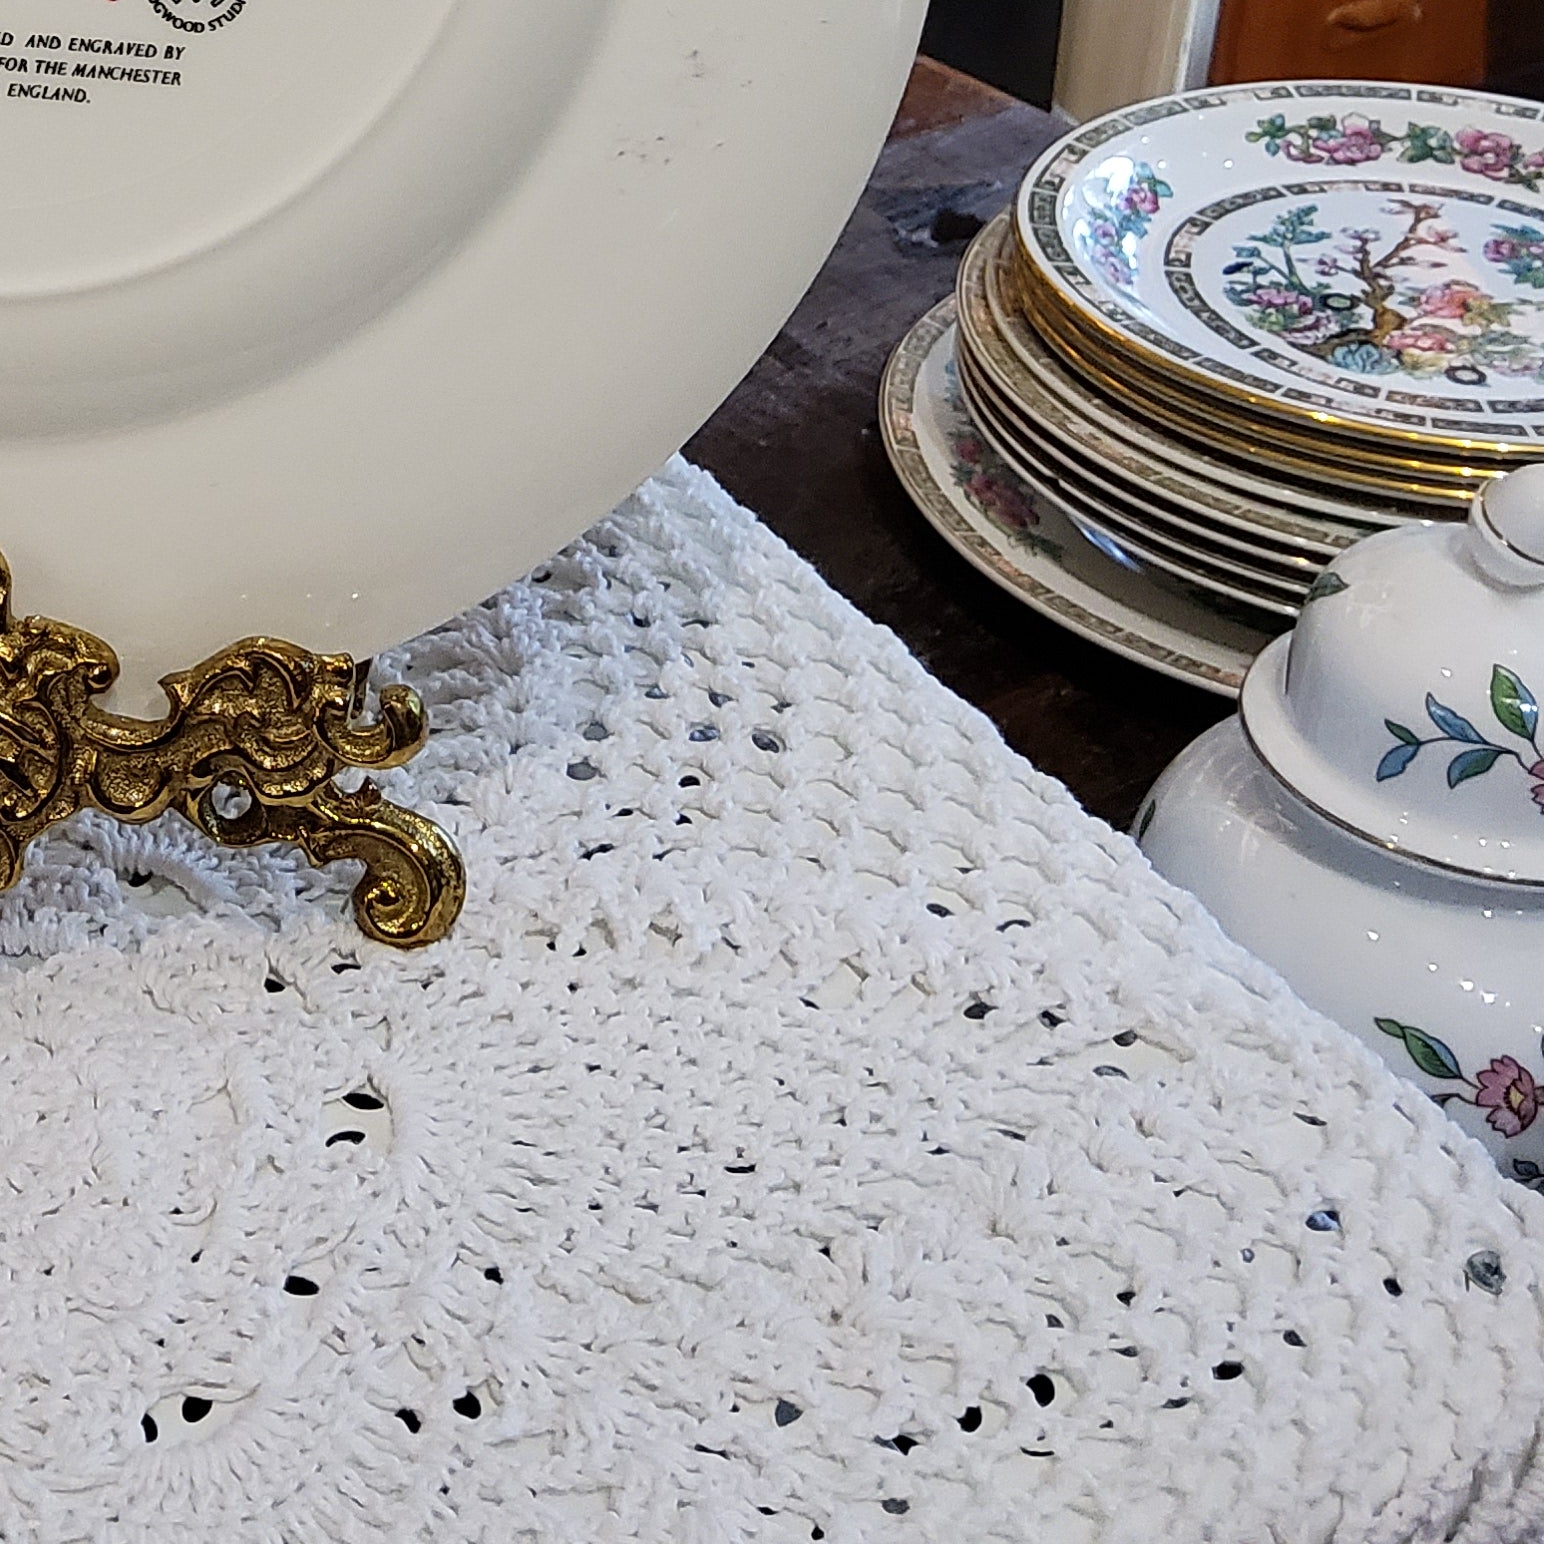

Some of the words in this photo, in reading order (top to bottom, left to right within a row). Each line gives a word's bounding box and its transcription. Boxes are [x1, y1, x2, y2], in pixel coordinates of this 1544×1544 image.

[25, 35, 61, 49] AND
[68, 38, 157, 58] ENGRAVED
[164, 46, 185, 60] BY
[35, 60, 68, 75] THE
[72, 64, 181, 86] MANCHESTER
[7, 83, 90, 103] ENGLAND.
